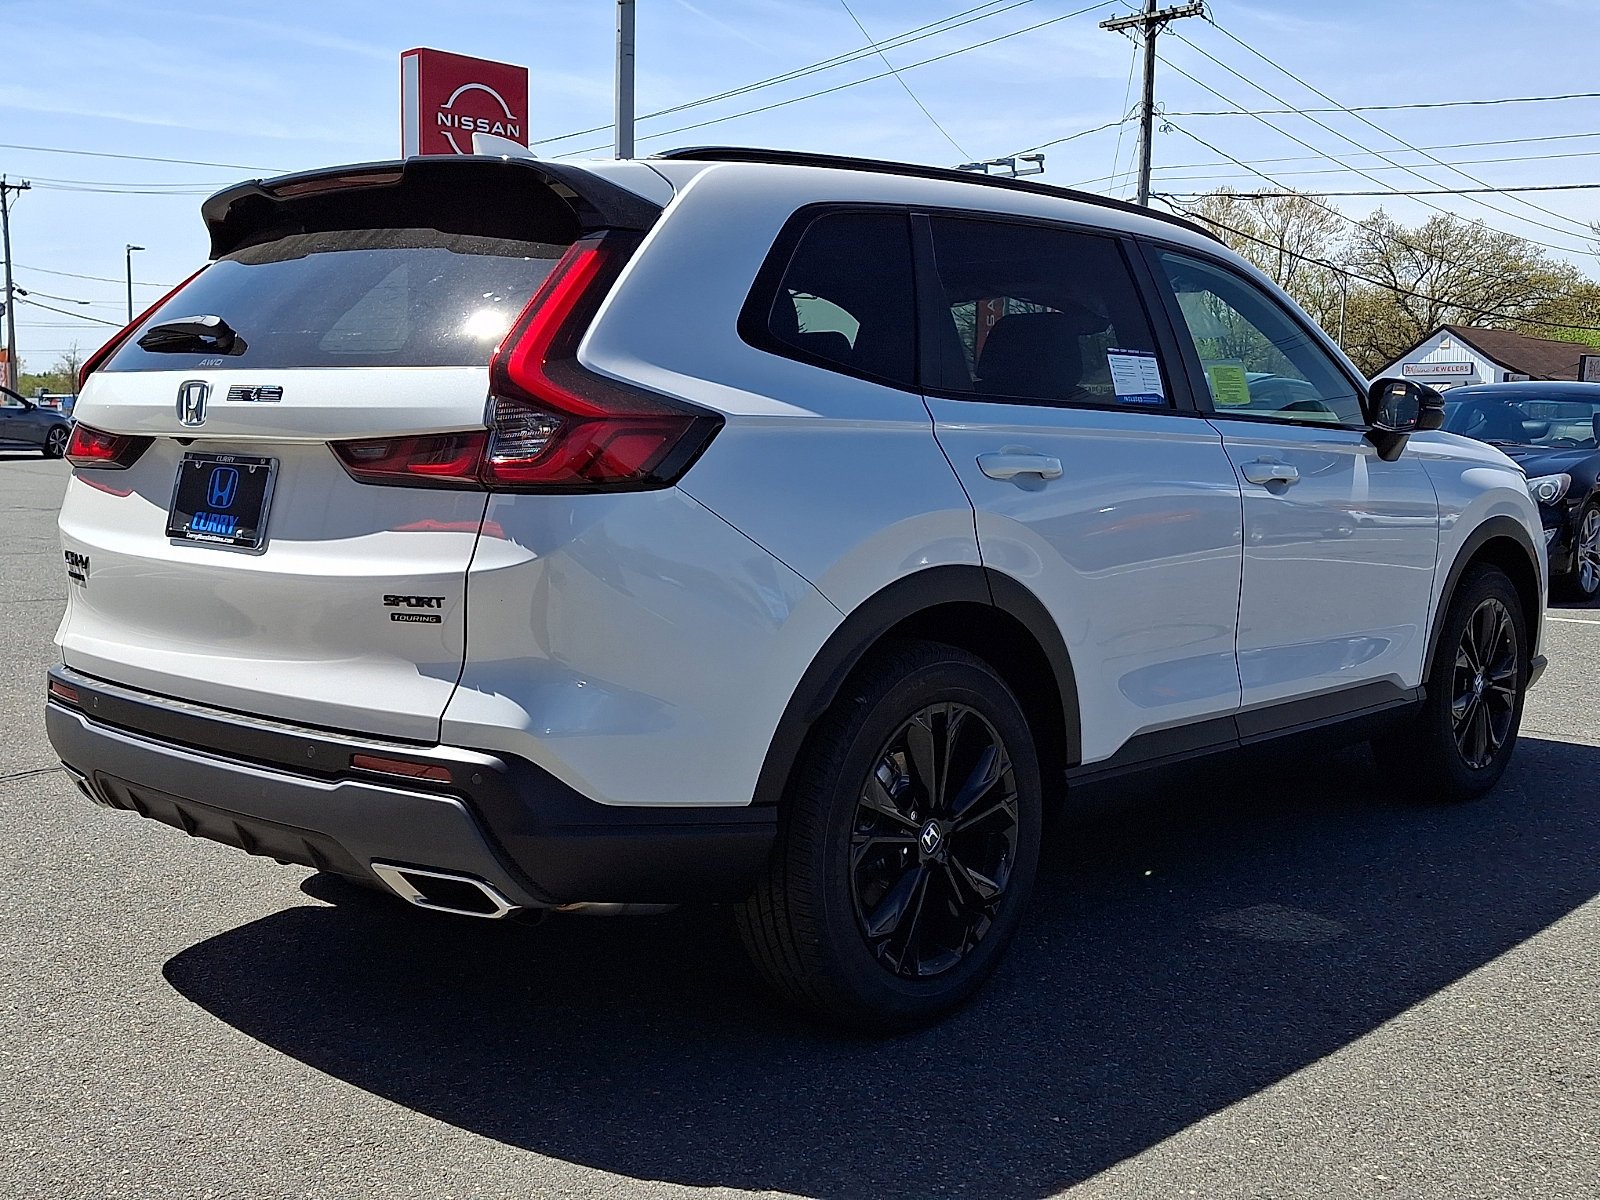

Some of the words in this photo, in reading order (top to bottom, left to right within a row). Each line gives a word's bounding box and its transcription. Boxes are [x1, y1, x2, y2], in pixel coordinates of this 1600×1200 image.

[437, 111, 520, 138] NISSAN
[199, 358, 223, 366] AWD
[1431, 365, 1469, 373] JEWELERS
[191, 512, 239, 535] CURRY
[383, 594, 446, 609] SPORT
[393, 614, 437, 623] TOURING
